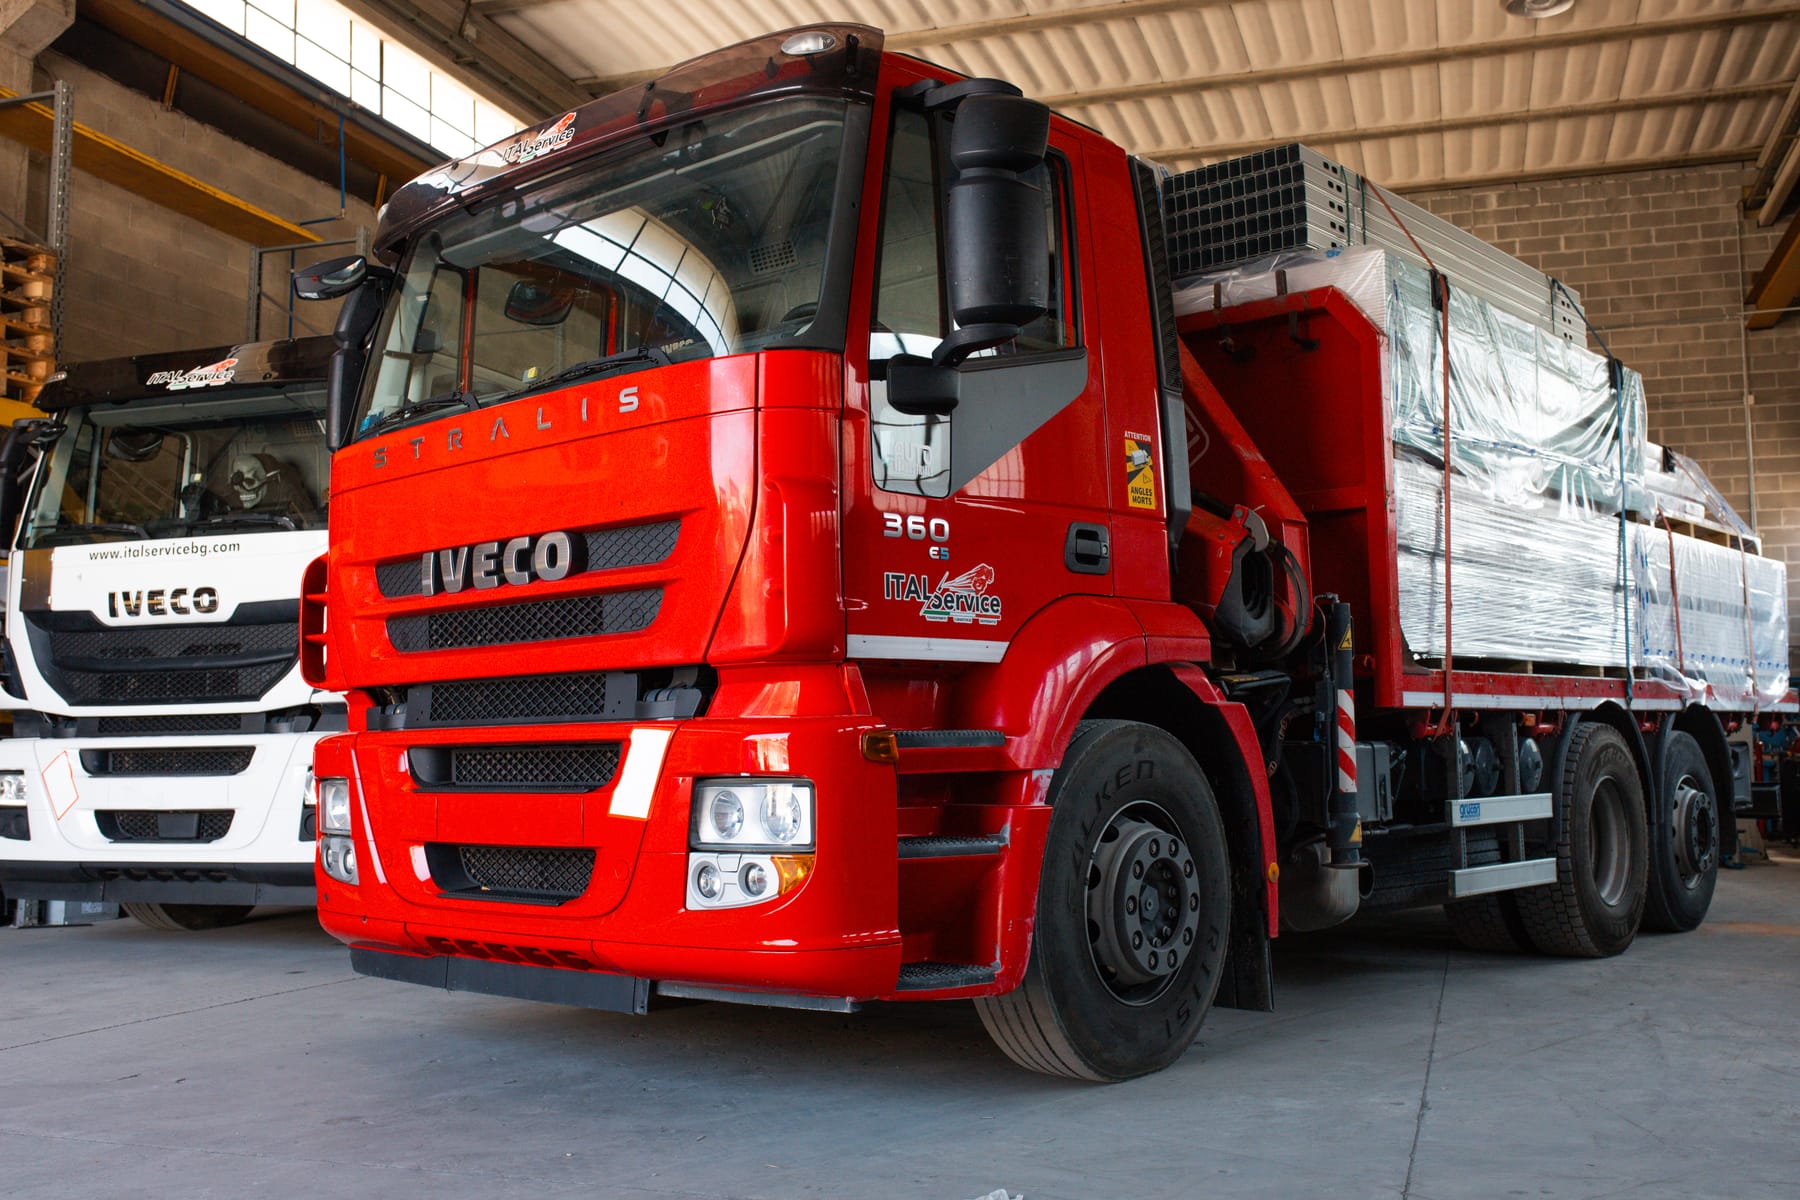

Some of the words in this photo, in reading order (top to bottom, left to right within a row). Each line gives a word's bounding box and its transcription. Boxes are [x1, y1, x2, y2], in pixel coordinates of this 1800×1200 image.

[373, 386, 639, 468] STRALIS
[1124, 430, 1151, 442] ATTENTION
[1130, 486, 1153, 497] ANGLES
[1131, 496, 1153, 506] MORTS
[883, 512, 950, 542] 360
[89, 541, 241, 561] www.italservicebg.com
[928, 546, 950, 561] E5
[421, 531, 573, 597] IVECO
[108, 587, 220, 618] IVECO
